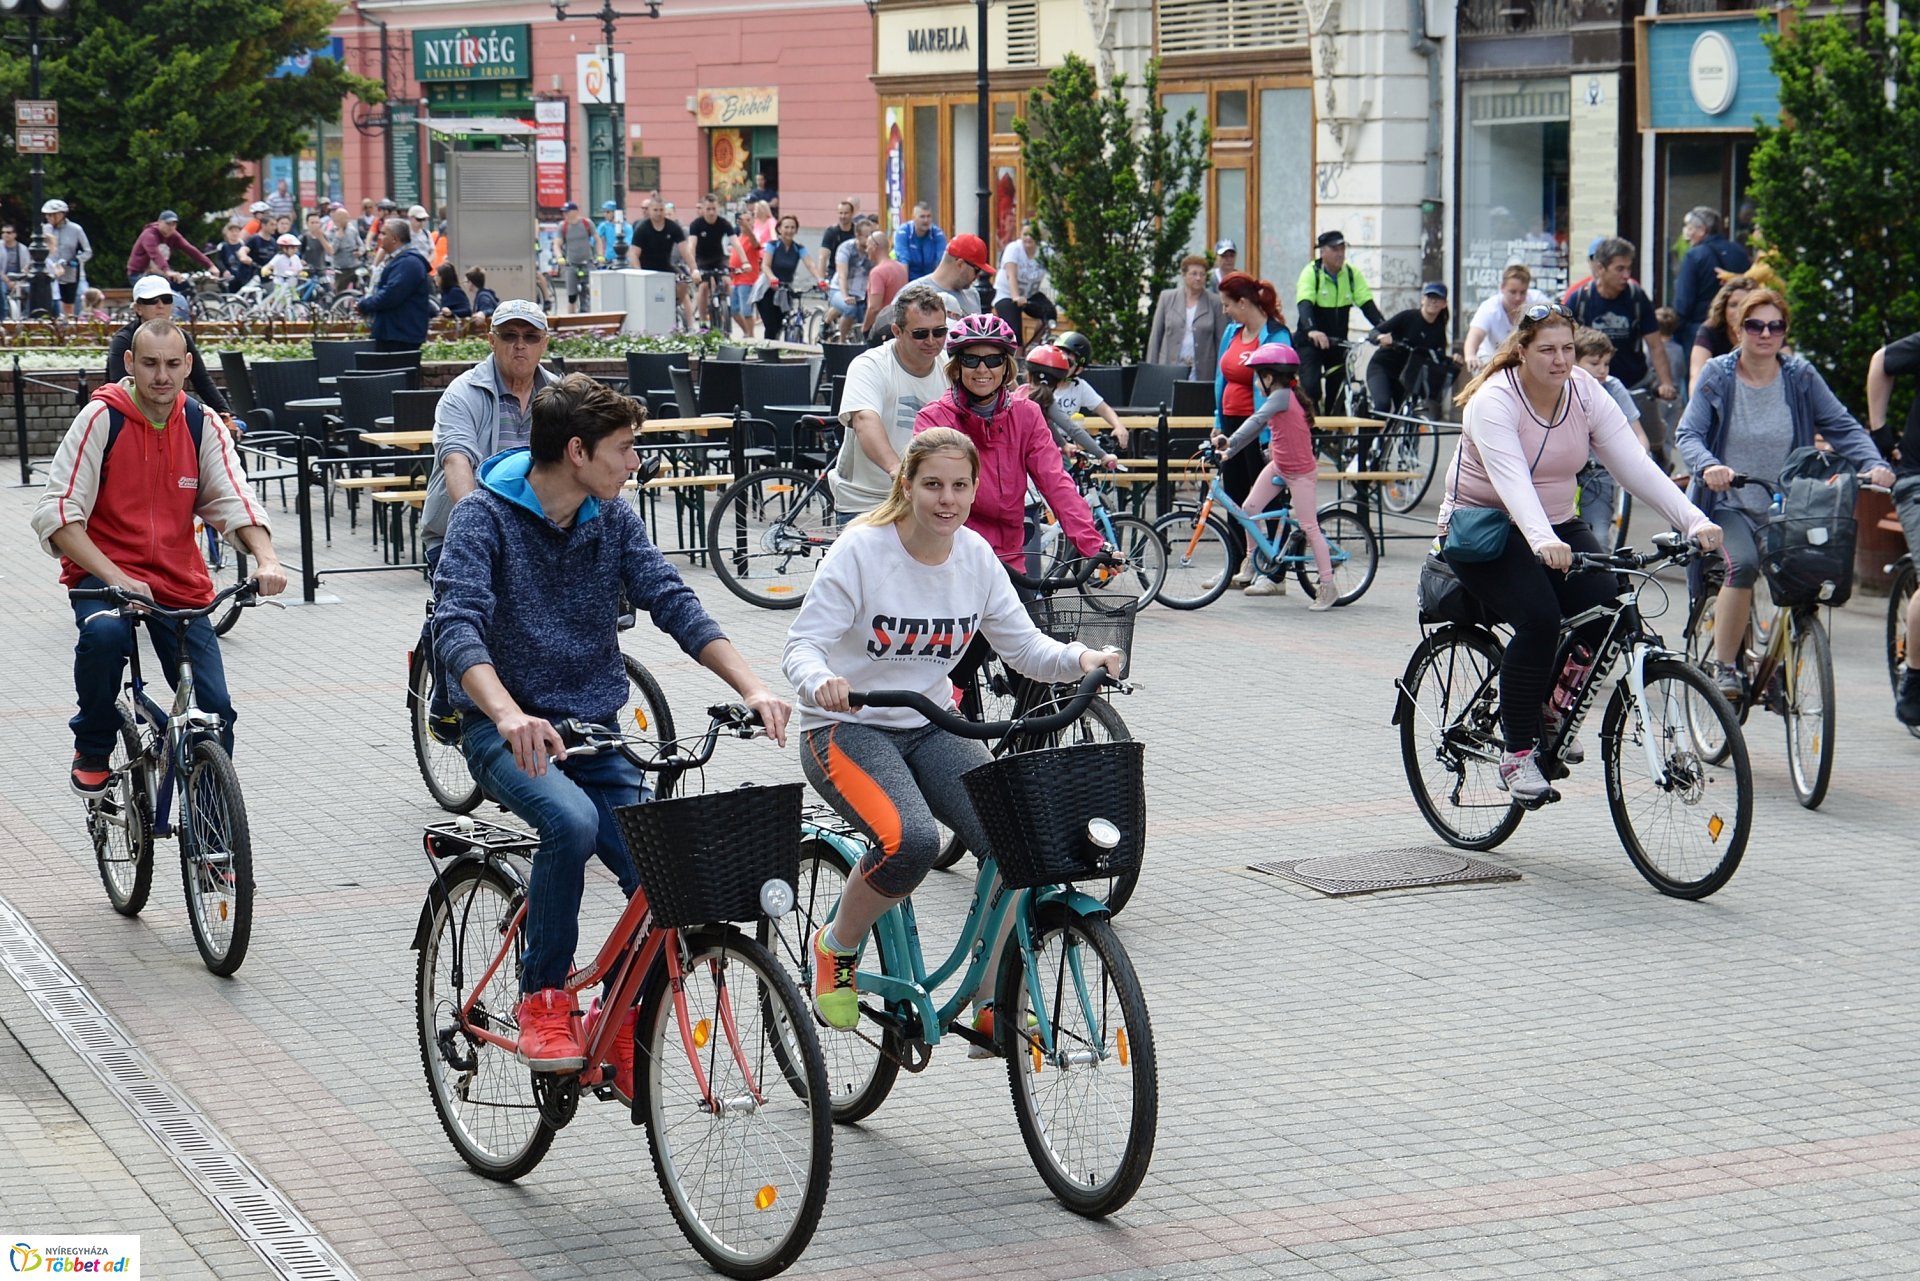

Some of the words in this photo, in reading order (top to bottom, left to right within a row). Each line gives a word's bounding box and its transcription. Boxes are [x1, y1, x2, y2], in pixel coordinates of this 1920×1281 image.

[424, 29, 516, 66] NYÍRSÉG
[908, 26, 970, 52] MARELLA
[425, 67, 471, 79] UTAZÁSI
[481, 66, 516, 77] IRODA
[1057, 397, 1077, 408] ACK
[867, 613, 977, 657] STAY
[1557, 640, 1620, 760] DYNAMICS
